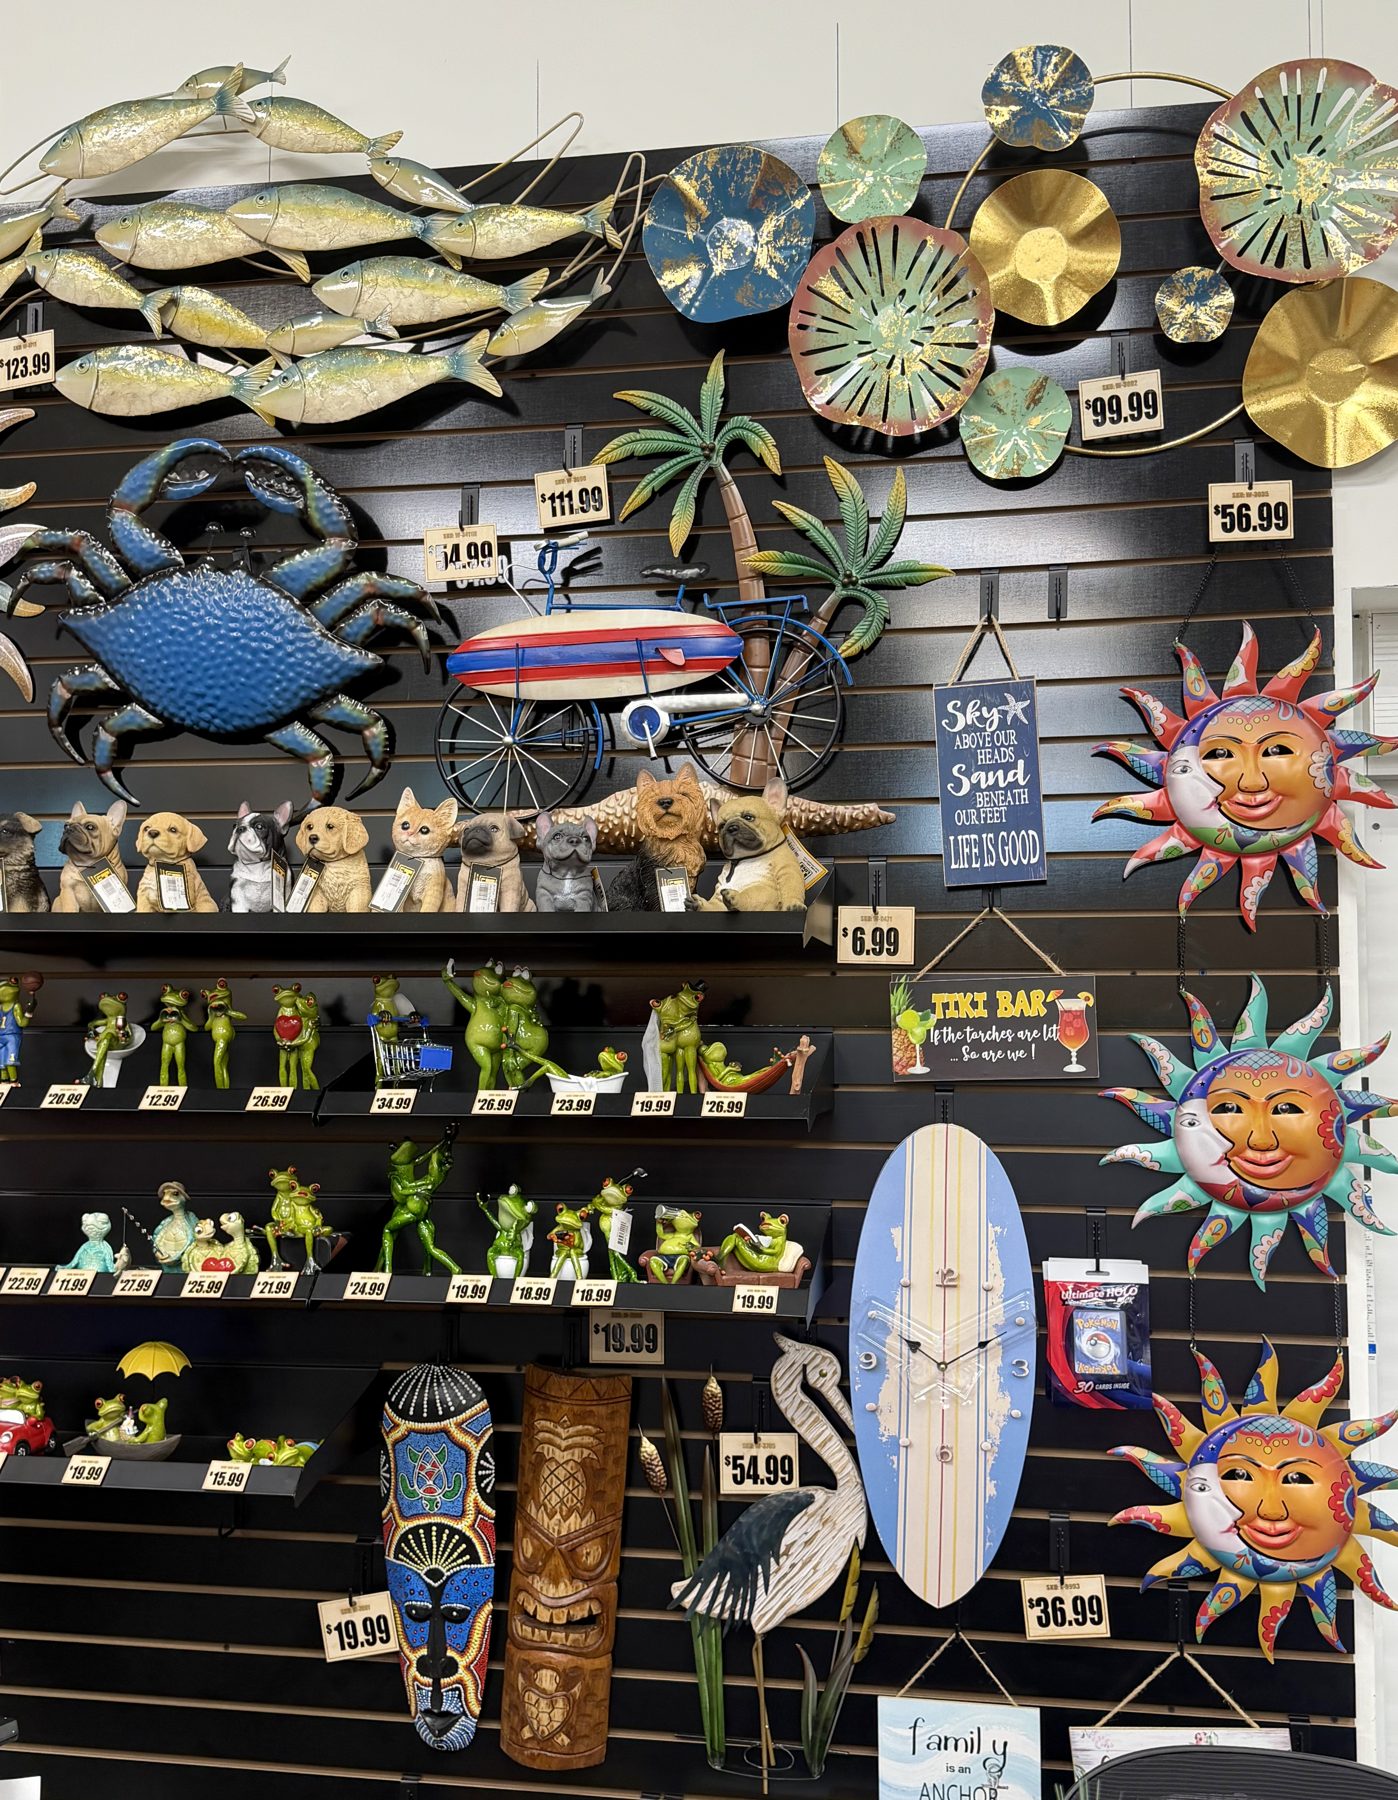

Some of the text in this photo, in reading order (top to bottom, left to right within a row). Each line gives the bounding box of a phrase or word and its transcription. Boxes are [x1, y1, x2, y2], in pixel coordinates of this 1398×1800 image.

[0, 351, 50, 380] $123.99
[1084, 389, 1159, 427] $99.99
[540, 486, 604, 517] $111.99
[1213, 501, 1289, 533] $56.99
[941, 699, 1003, 733] Sky
[954, 729, 1018, 750] ABOVE OUR
[977, 747, 1015, 765] HEADS
[947, 759, 1031, 797] Sand
[976, 788, 1030, 809] BENEATH
[954, 806, 1008, 826] OUR FEET
[949, 829, 1040, 869] LIFE IS GOOD
[842, 926, 900, 957] $6.99
[931, 989, 1048, 1020] TIKI BAR
[930, 1023, 1061, 1046] If the torches are lit
[961, 1045, 979, 1062] So
[981, 1049, 1006, 1061] are
[1007, 1049, 1028, 1061] we
[935, 1267, 959, 1288] 12
[736, 1294, 775, 1310] $19.99
[1061, 1288, 1105, 1300] Ultimate
[593, 1323, 659, 1354] $19.99
[859, 1352, 878, 1370] 9
[1011, 1359, 1030, 1378] 3
[1074, 1381, 1094, 1393] 30
[724, 1454, 794, 1486] $54.99
[1027, 1594, 1104, 1628] $36.99
[325, 1613, 391, 1651] $19.99
[908, 1716, 1008, 1779] family
[946, 1763, 971, 1774] is an
